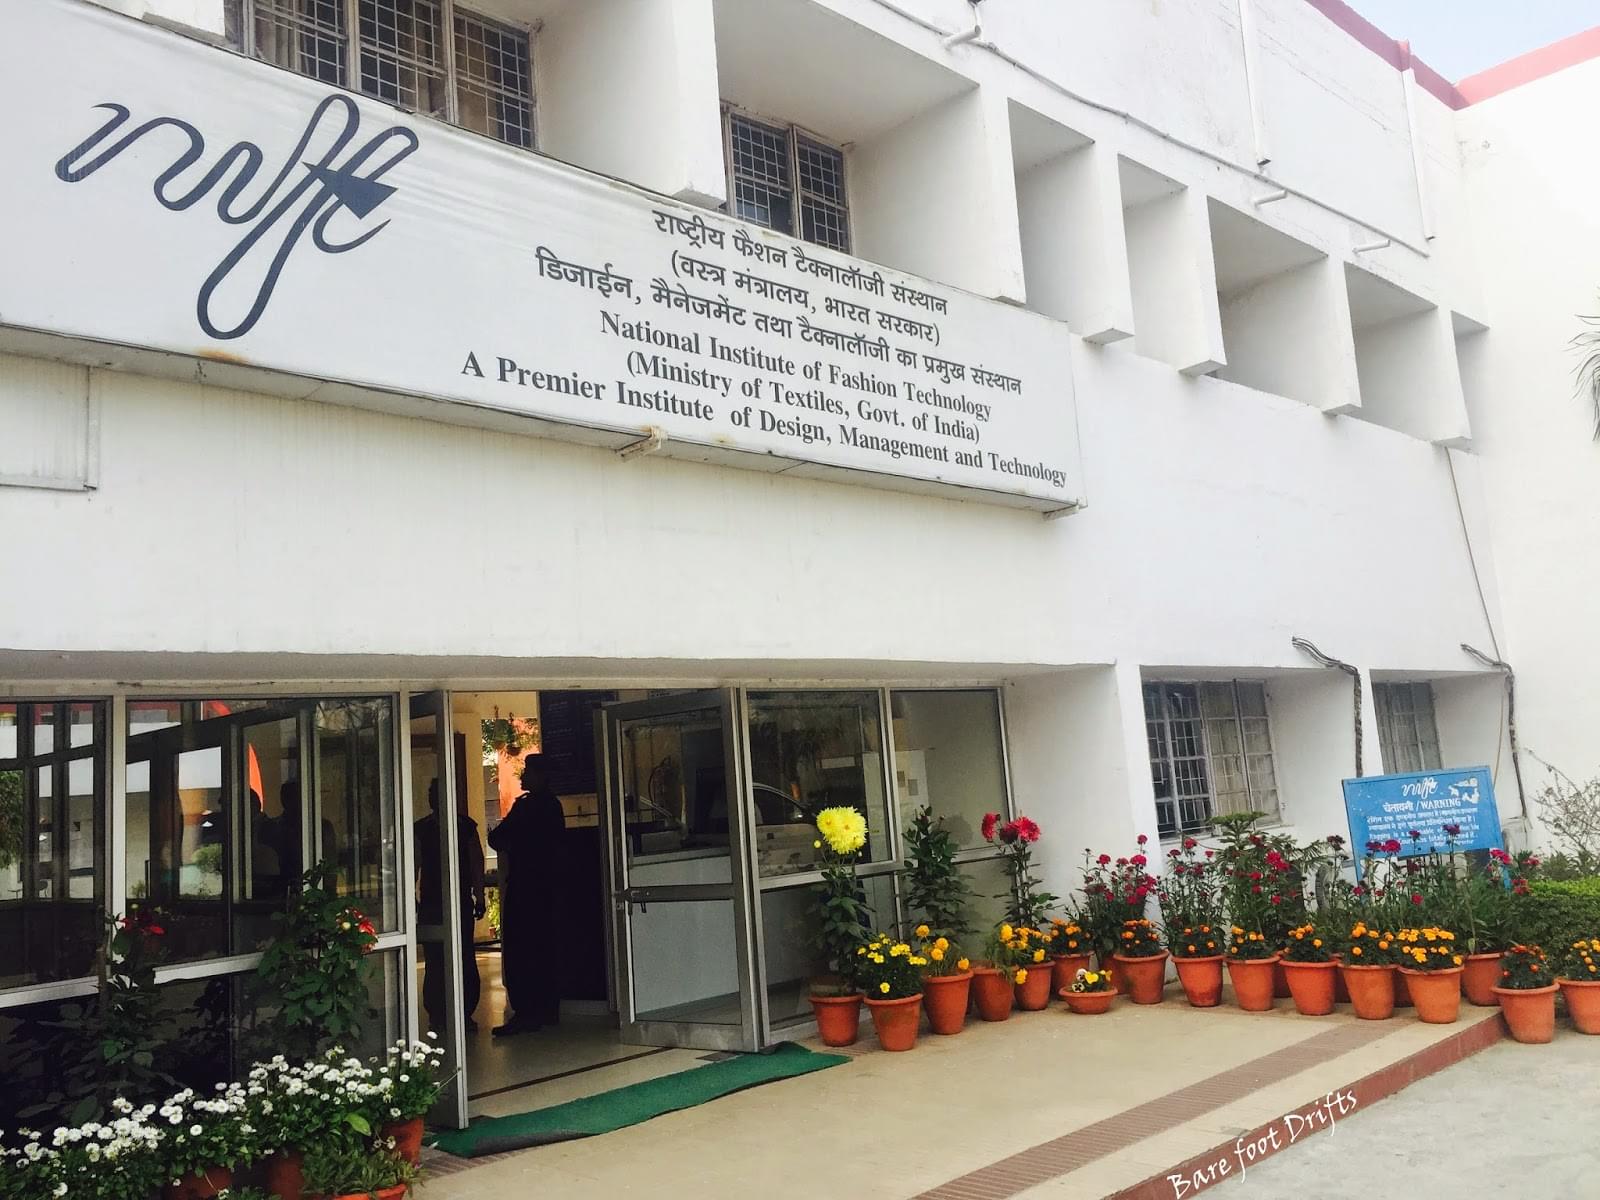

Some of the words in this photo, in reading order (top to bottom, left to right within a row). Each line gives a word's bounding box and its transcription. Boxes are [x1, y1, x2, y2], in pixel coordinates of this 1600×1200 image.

[651, 209, 726, 251] राष्ट्रीय
[731, 229, 788, 269] फैशन
[793, 246, 885, 297] टैक्नालॉजी
[889, 280, 948, 316] संस्थान
[671, 249, 727, 287] (वस्त्र
[732, 267, 817, 315] मंत्रालय,
[824, 296, 871, 326] भारत
[875, 310, 940, 347] सरकार)
[534, 245, 642, 306] डिजाईन,
[649, 277, 747, 326] मैनेजमेंट
[752, 311, 793, 339] तथा
[798, 315, 891, 363] टैक्नालॉजी
[894, 347, 918, 369] का
[921, 354, 966, 385] प्रमुख
[969, 363, 1022, 396] संस्थान
[599, 309, 701, 355] National
[708, 335, 796, 376] Institute
[802, 360, 823, 382] of
[828, 363, 898, 398] Fashion
[902, 381, 992, 423] Technology
[460, 350, 486, 379] A
[495, 356, 607, 401] Premier
[615, 380, 714, 421] Institute
[730, 406, 753, 428] of
[758, 409, 832, 446] Design,
[838, 423, 950, 463] Management
[954, 449, 984, 469] and
[987, 452, 1067, 489] Technology
[626, 350, 733, 398] (Ministry
[741, 377, 763, 400] of
[768, 381, 850, 420] Textiles,
[857, 399, 905, 428] Govt.
[911, 412, 929, 432] of
[934, 415, 980, 445] India)
